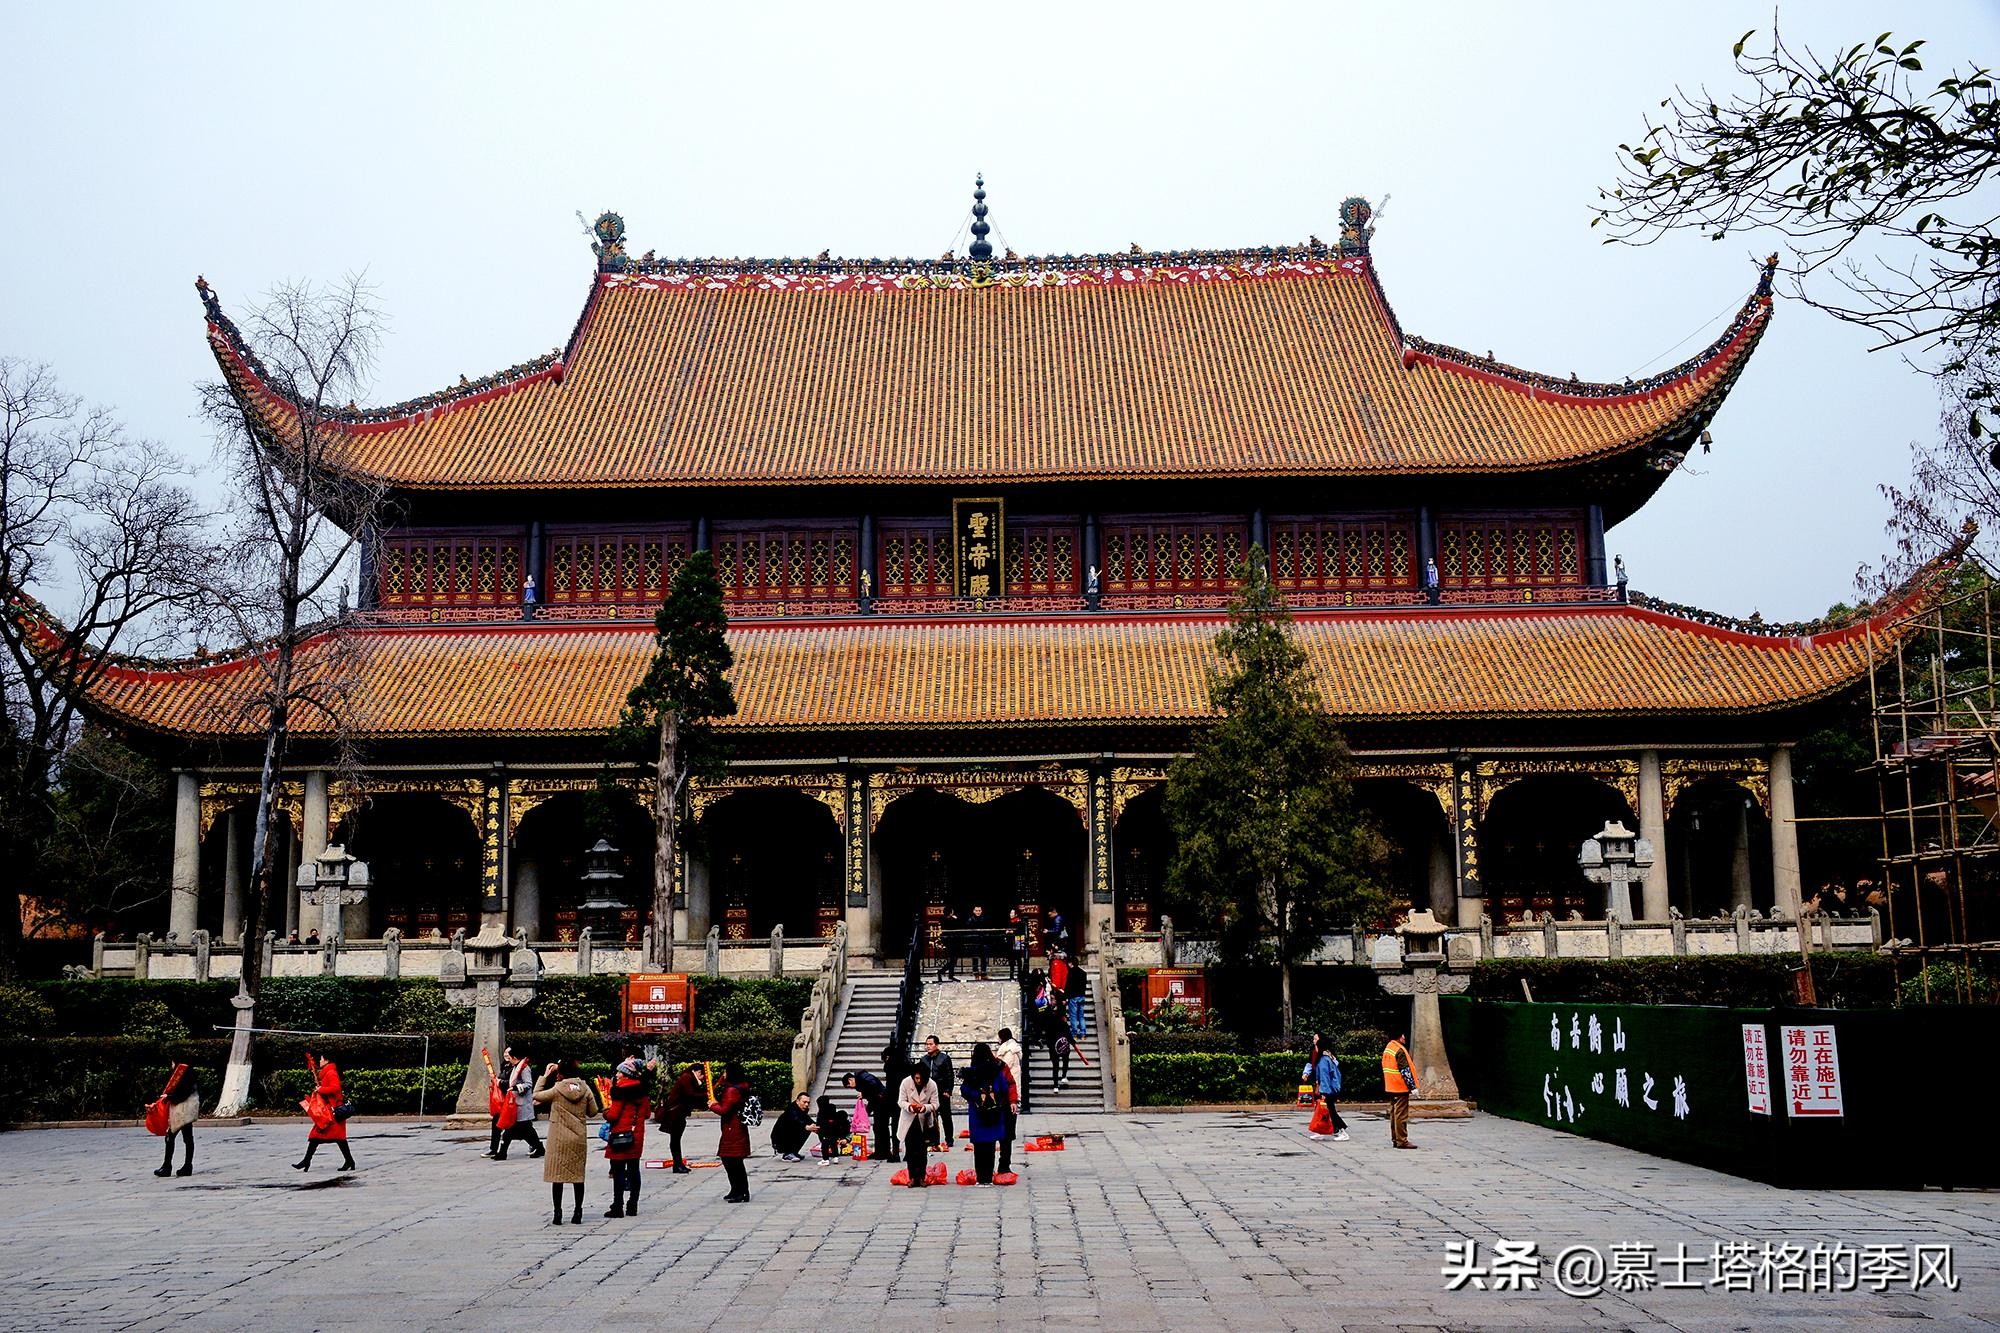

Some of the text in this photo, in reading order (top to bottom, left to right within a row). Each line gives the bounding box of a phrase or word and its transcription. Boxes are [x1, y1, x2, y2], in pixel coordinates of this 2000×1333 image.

[968, 512, 990, 597] 聖帝殿
[1744, 1029, 1757, 1095] 请勿靠近
[1754, 1030, 1766, 1095] 正在施工
[1787, 1029, 1812, 1100] 请勿靠近
[1813, 1030, 1837, 1100] 正在施工
